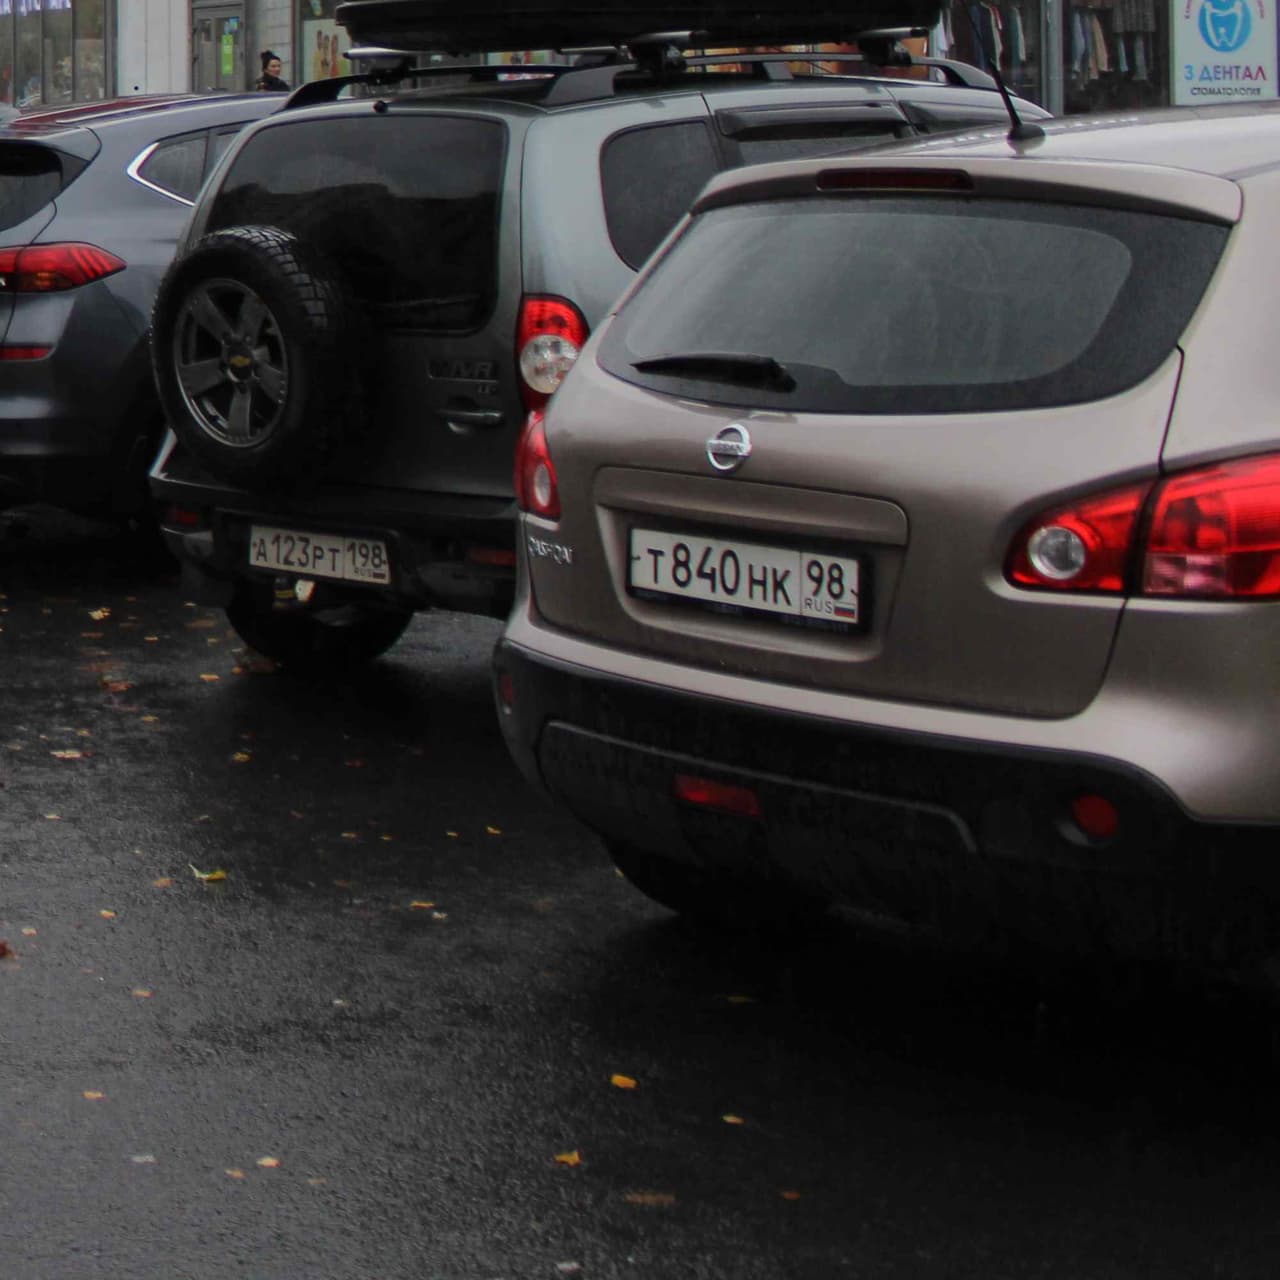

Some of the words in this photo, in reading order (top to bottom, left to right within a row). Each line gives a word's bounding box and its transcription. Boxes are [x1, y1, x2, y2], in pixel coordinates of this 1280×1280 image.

[1198, 65, 1267, 82] ДЕНТАЛ
[1190, 87, 1262, 96] СТОМАТОЛОГИЯ
[256, 533, 340, 572] А123РТ
[347, 541, 383, 569] 198
[646, 542, 793, 607] Т840НК
[806, 558, 845, 600] 98
[804, 598, 834, 616] RUS
